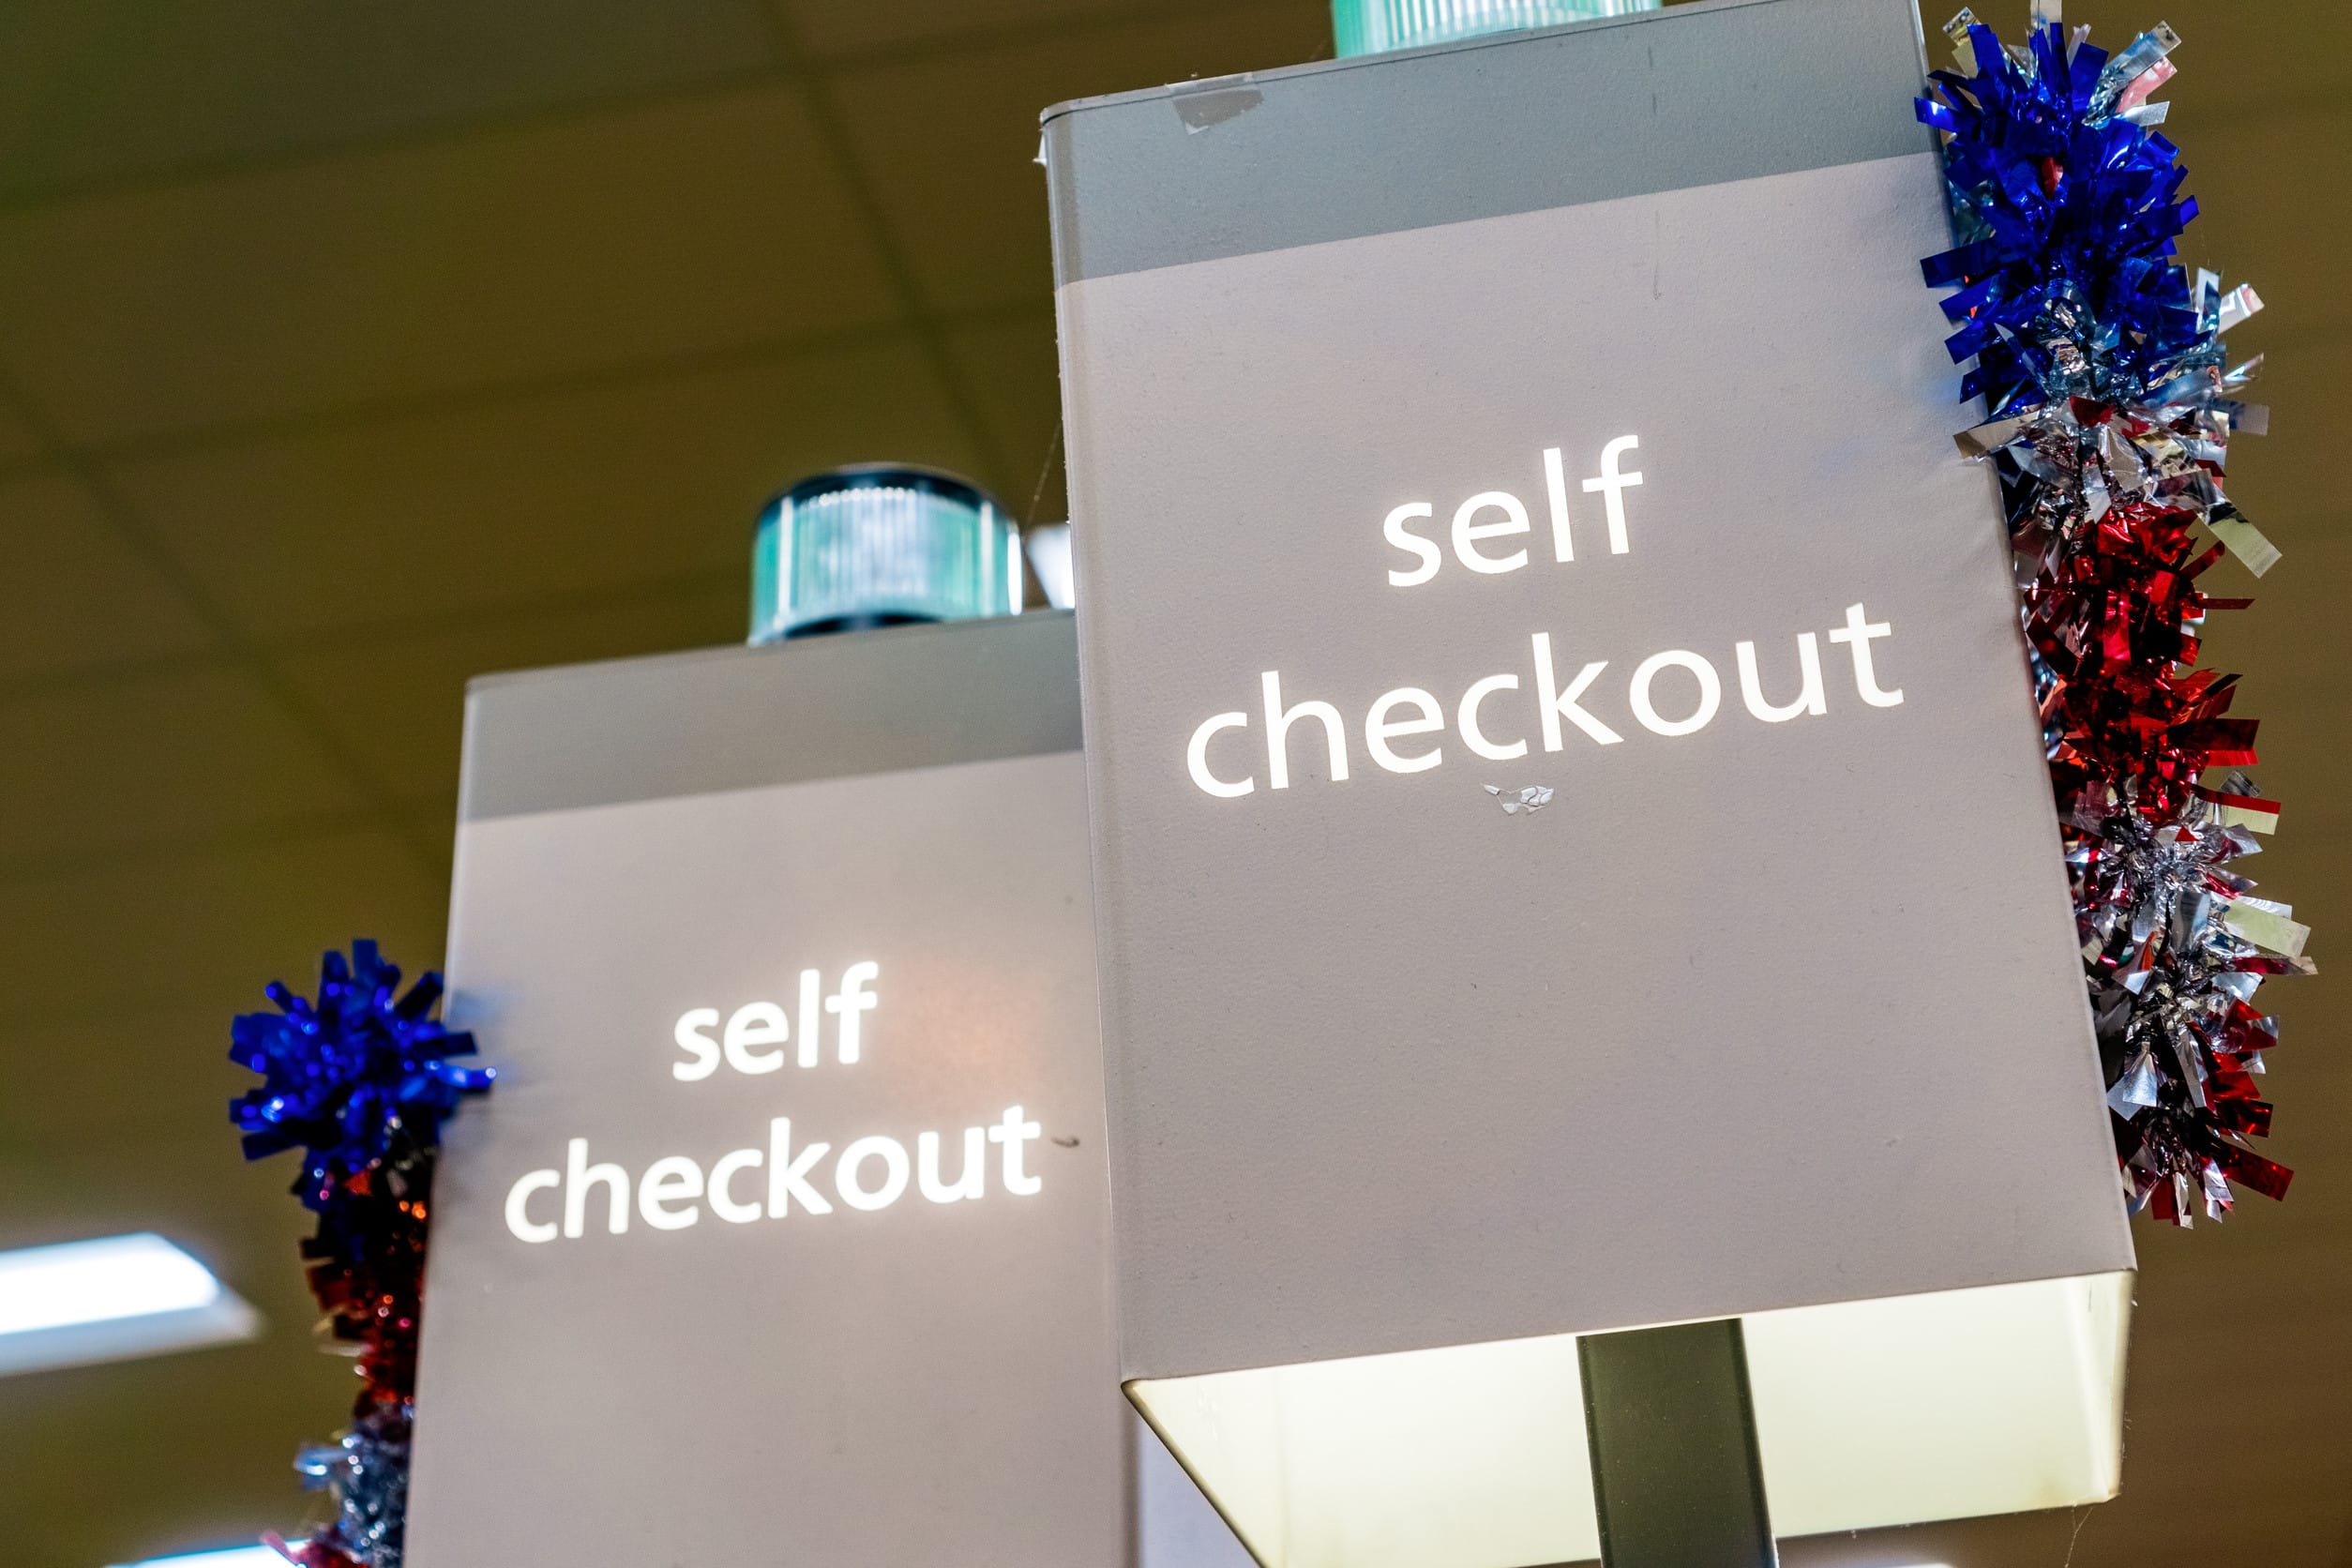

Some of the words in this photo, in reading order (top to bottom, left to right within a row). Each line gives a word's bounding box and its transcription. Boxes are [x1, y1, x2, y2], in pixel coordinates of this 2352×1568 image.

[1383, 434, 1644, 587] self
[1186, 603, 1904, 798] checkout
[672, 960, 879, 1081] self
[505, 1105, 1042, 1243] checkout
